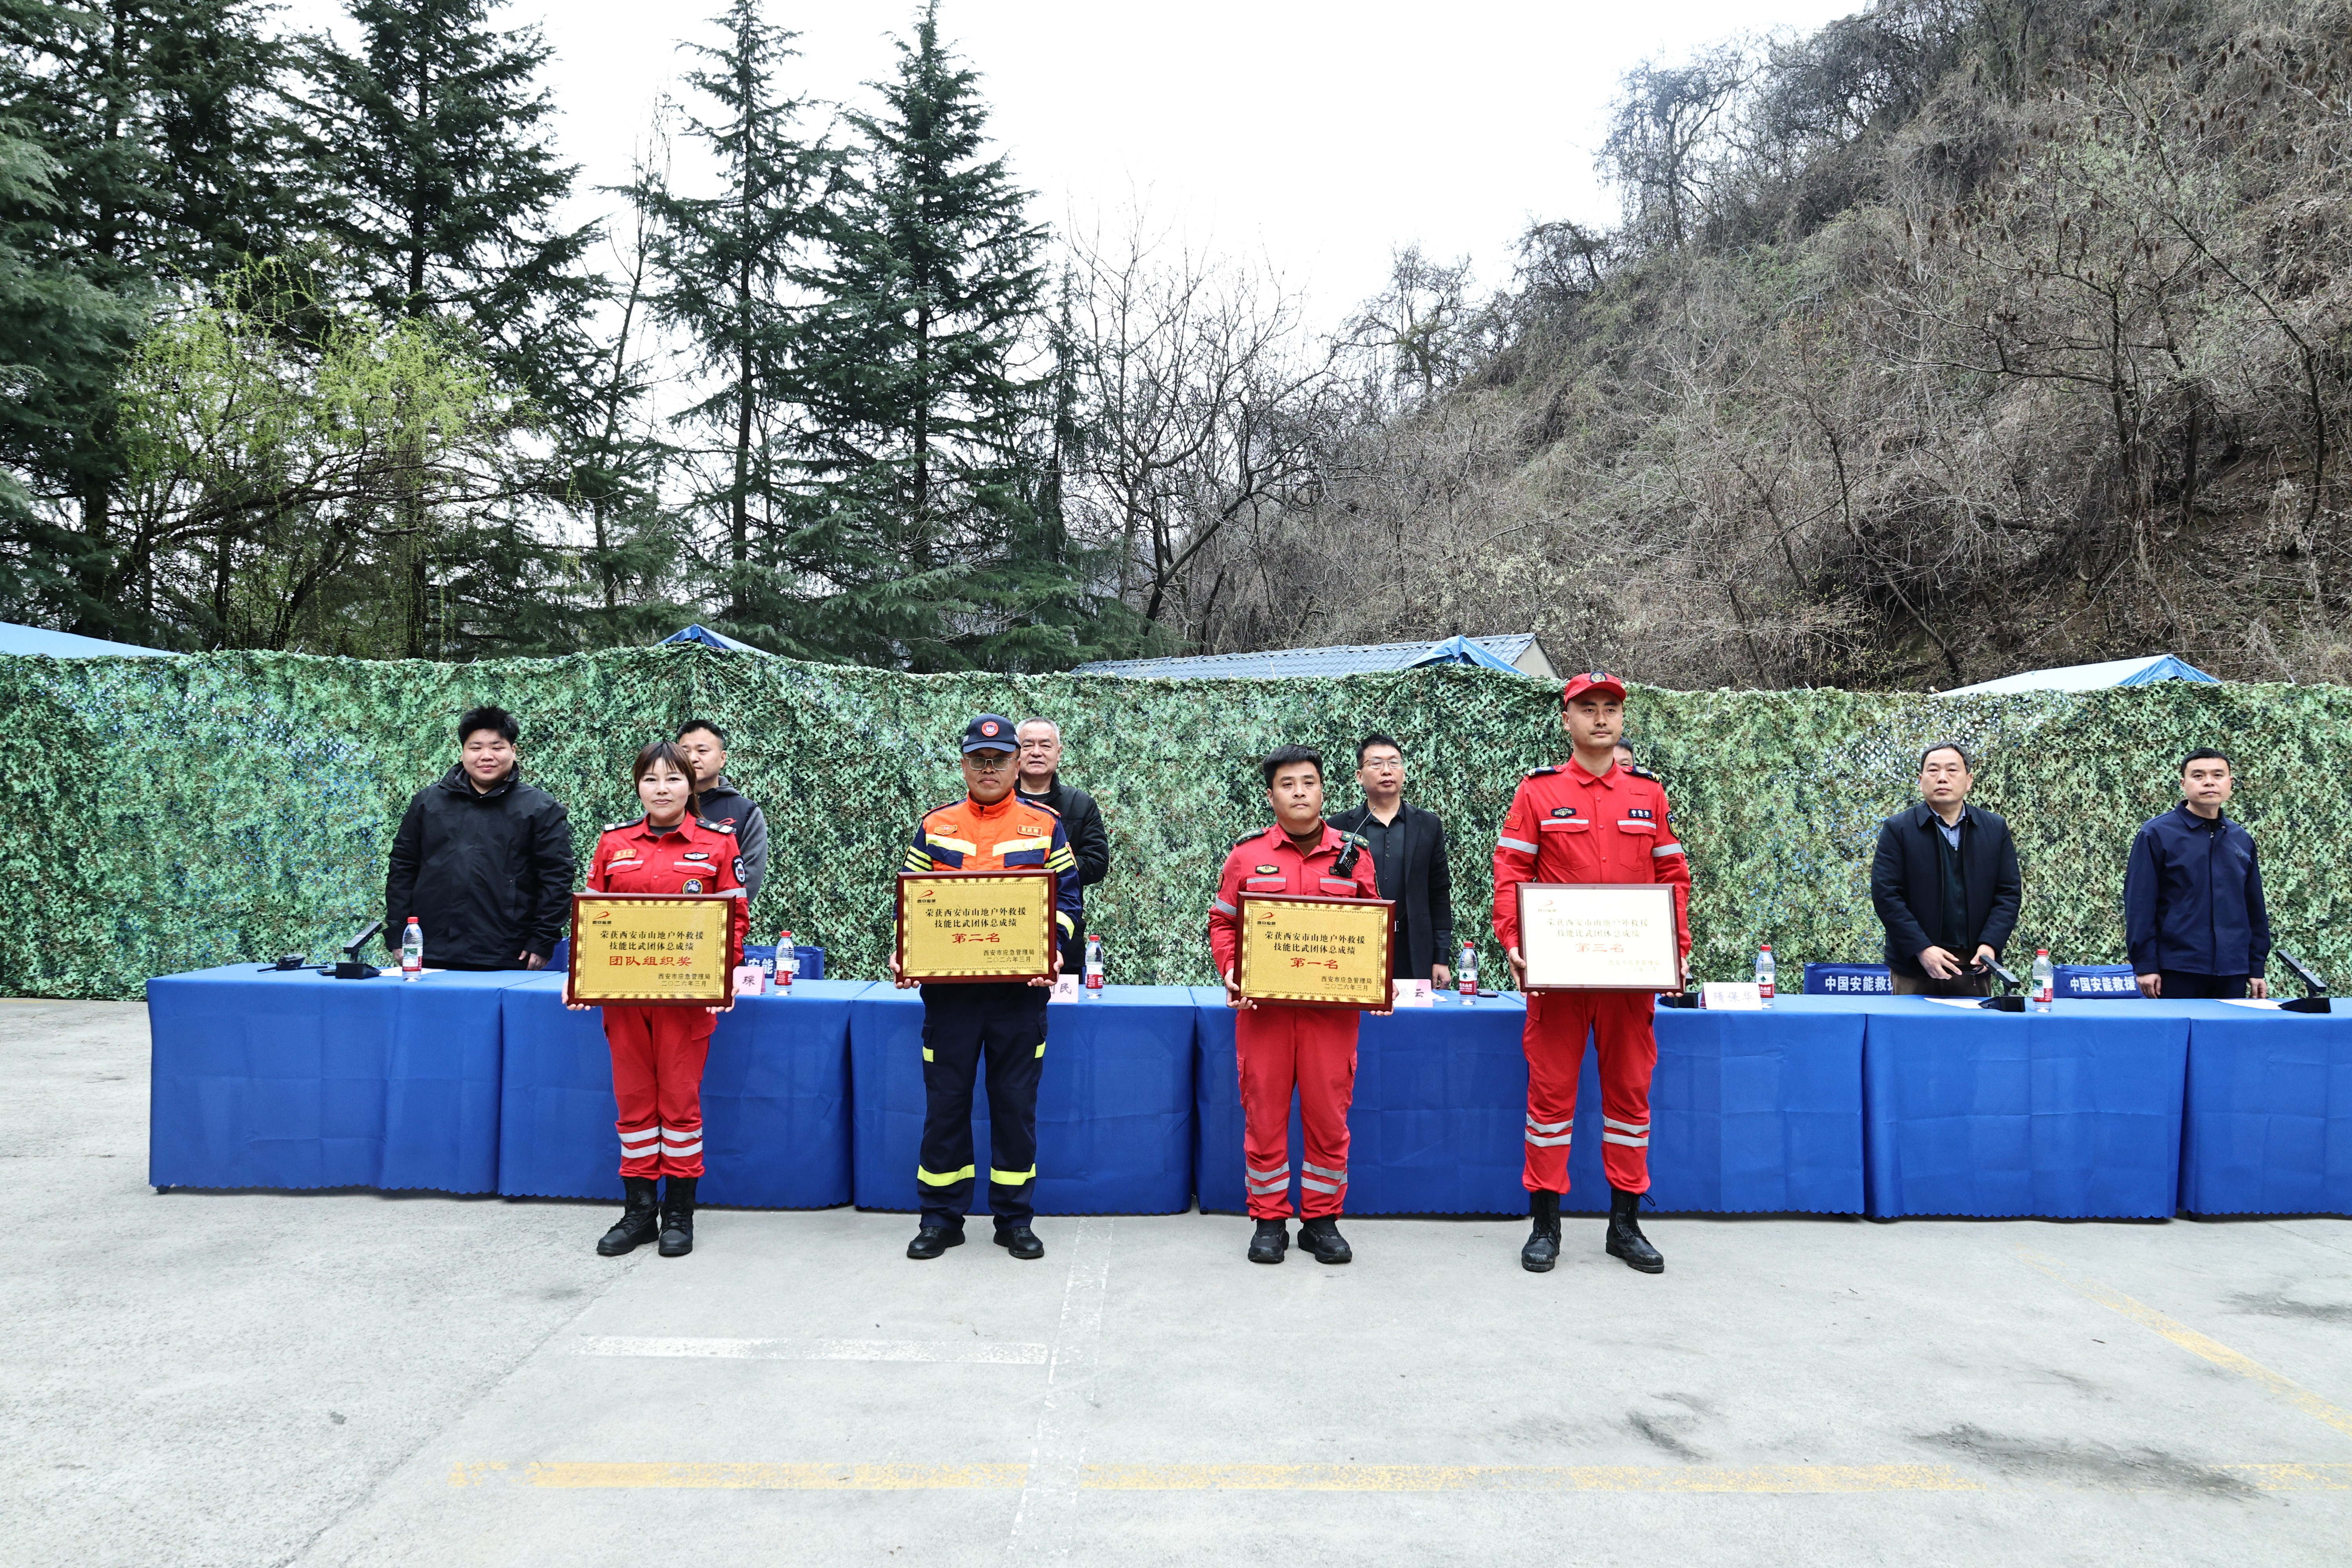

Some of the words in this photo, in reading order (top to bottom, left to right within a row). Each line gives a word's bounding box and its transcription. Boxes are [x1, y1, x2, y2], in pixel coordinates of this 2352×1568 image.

[925, 907, 1026, 917] 荣获西安市山地户外救援
[935, 918, 1017, 928] 技能比武团体总成绩
[1547, 918, 1648, 927] 荣获西安市山地户外救援
[601, 930, 704, 939] 荣获西安市山地户外救援
[952, 933, 1000, 944] 第二名
[1265, 931, 1365, 944] 荣获西安市山地户外救援
[609, 942, 694, 951] 技能比武团体总成绩
[1274, 942, 1356, 955] 技能比武团体总成绩
[1575, 943, 1624, 953] 第三名
[609, 956, 692, 966] 团队组织奖
[1290, 957, 1338, 969] 第一名
[1321, 976, 1372, 984] 西安市应急管理局
[2070, 976, 2136, 992] 中国安能救援
[1713, 991, 1754, 1004] 隋保华
